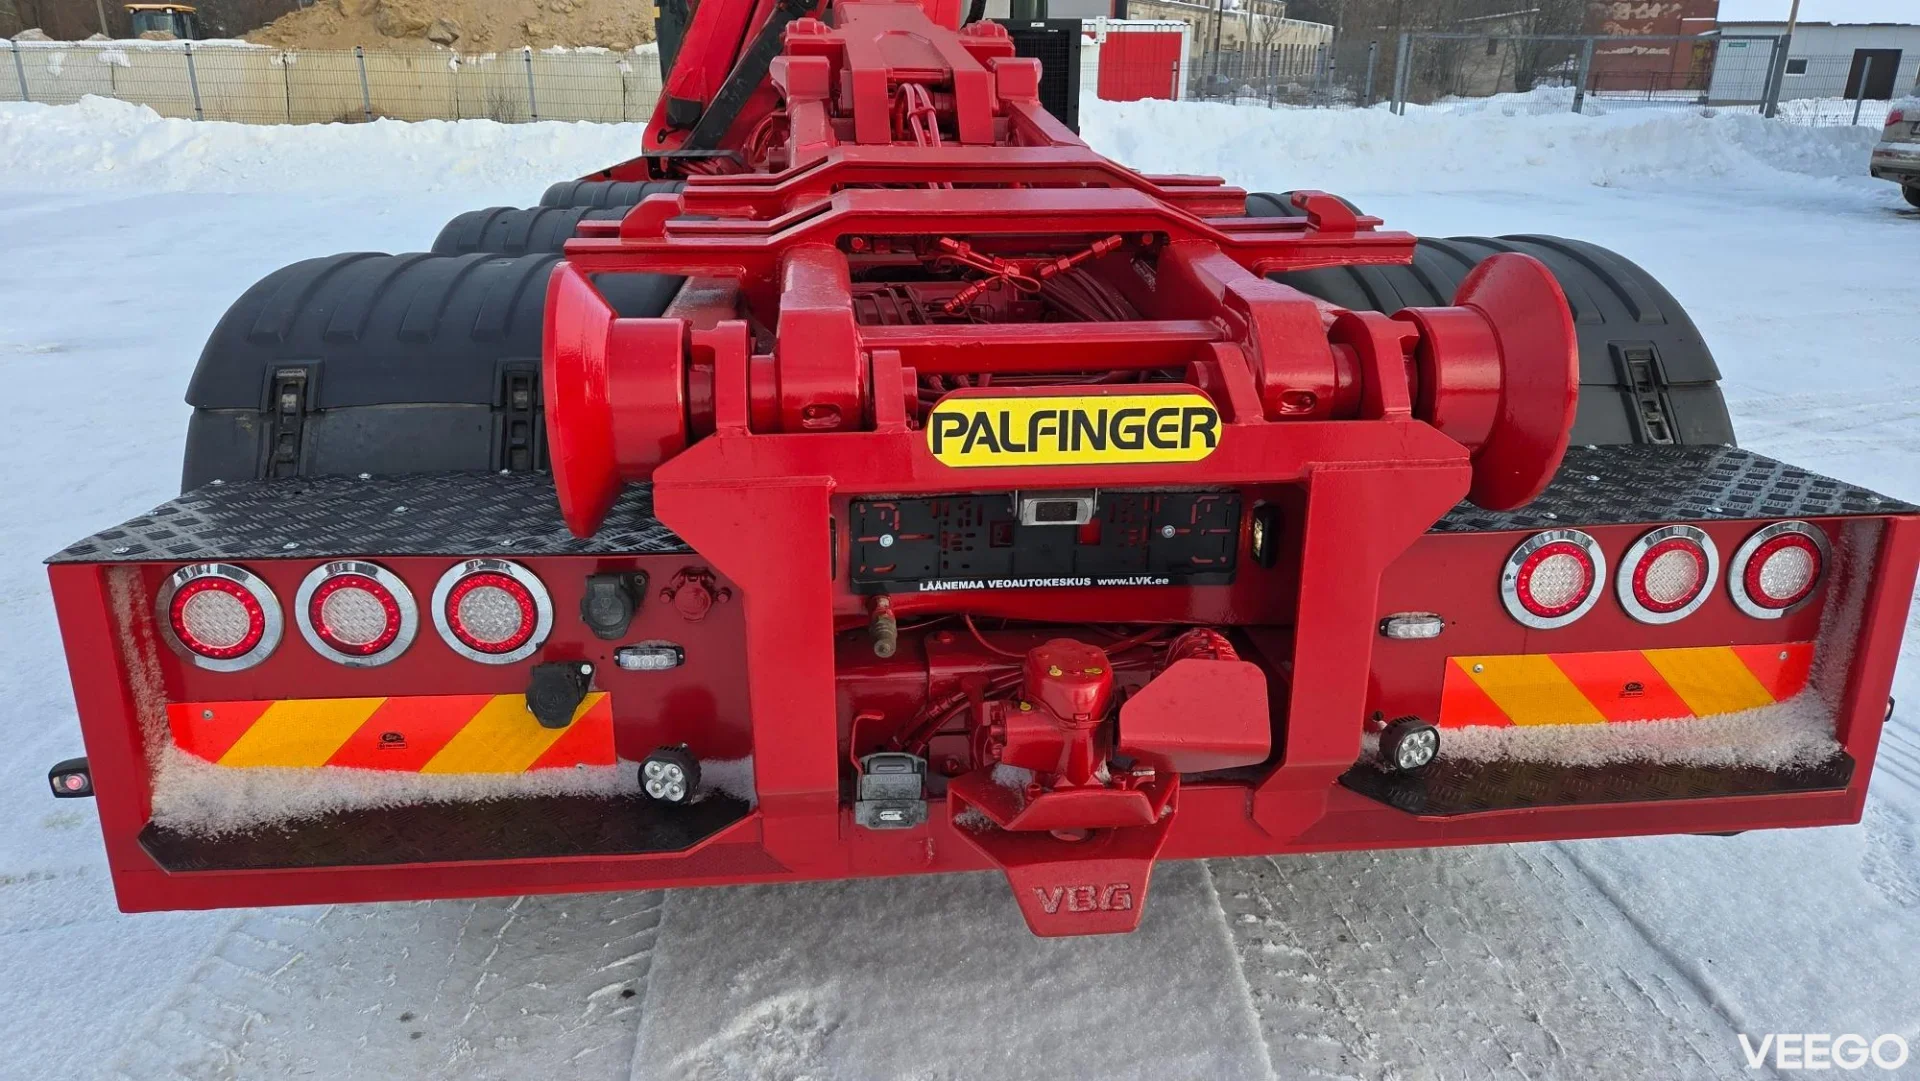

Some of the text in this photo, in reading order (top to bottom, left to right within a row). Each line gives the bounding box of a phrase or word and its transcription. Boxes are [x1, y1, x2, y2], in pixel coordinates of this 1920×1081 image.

[932, 407, 1217, 454] PALFINGER
[919, 576, 1169, 591] LÄÄNEMAA VEOAUTOKESKUS www.LVK.ee
[1032, 883, 1132, 914] VBG
